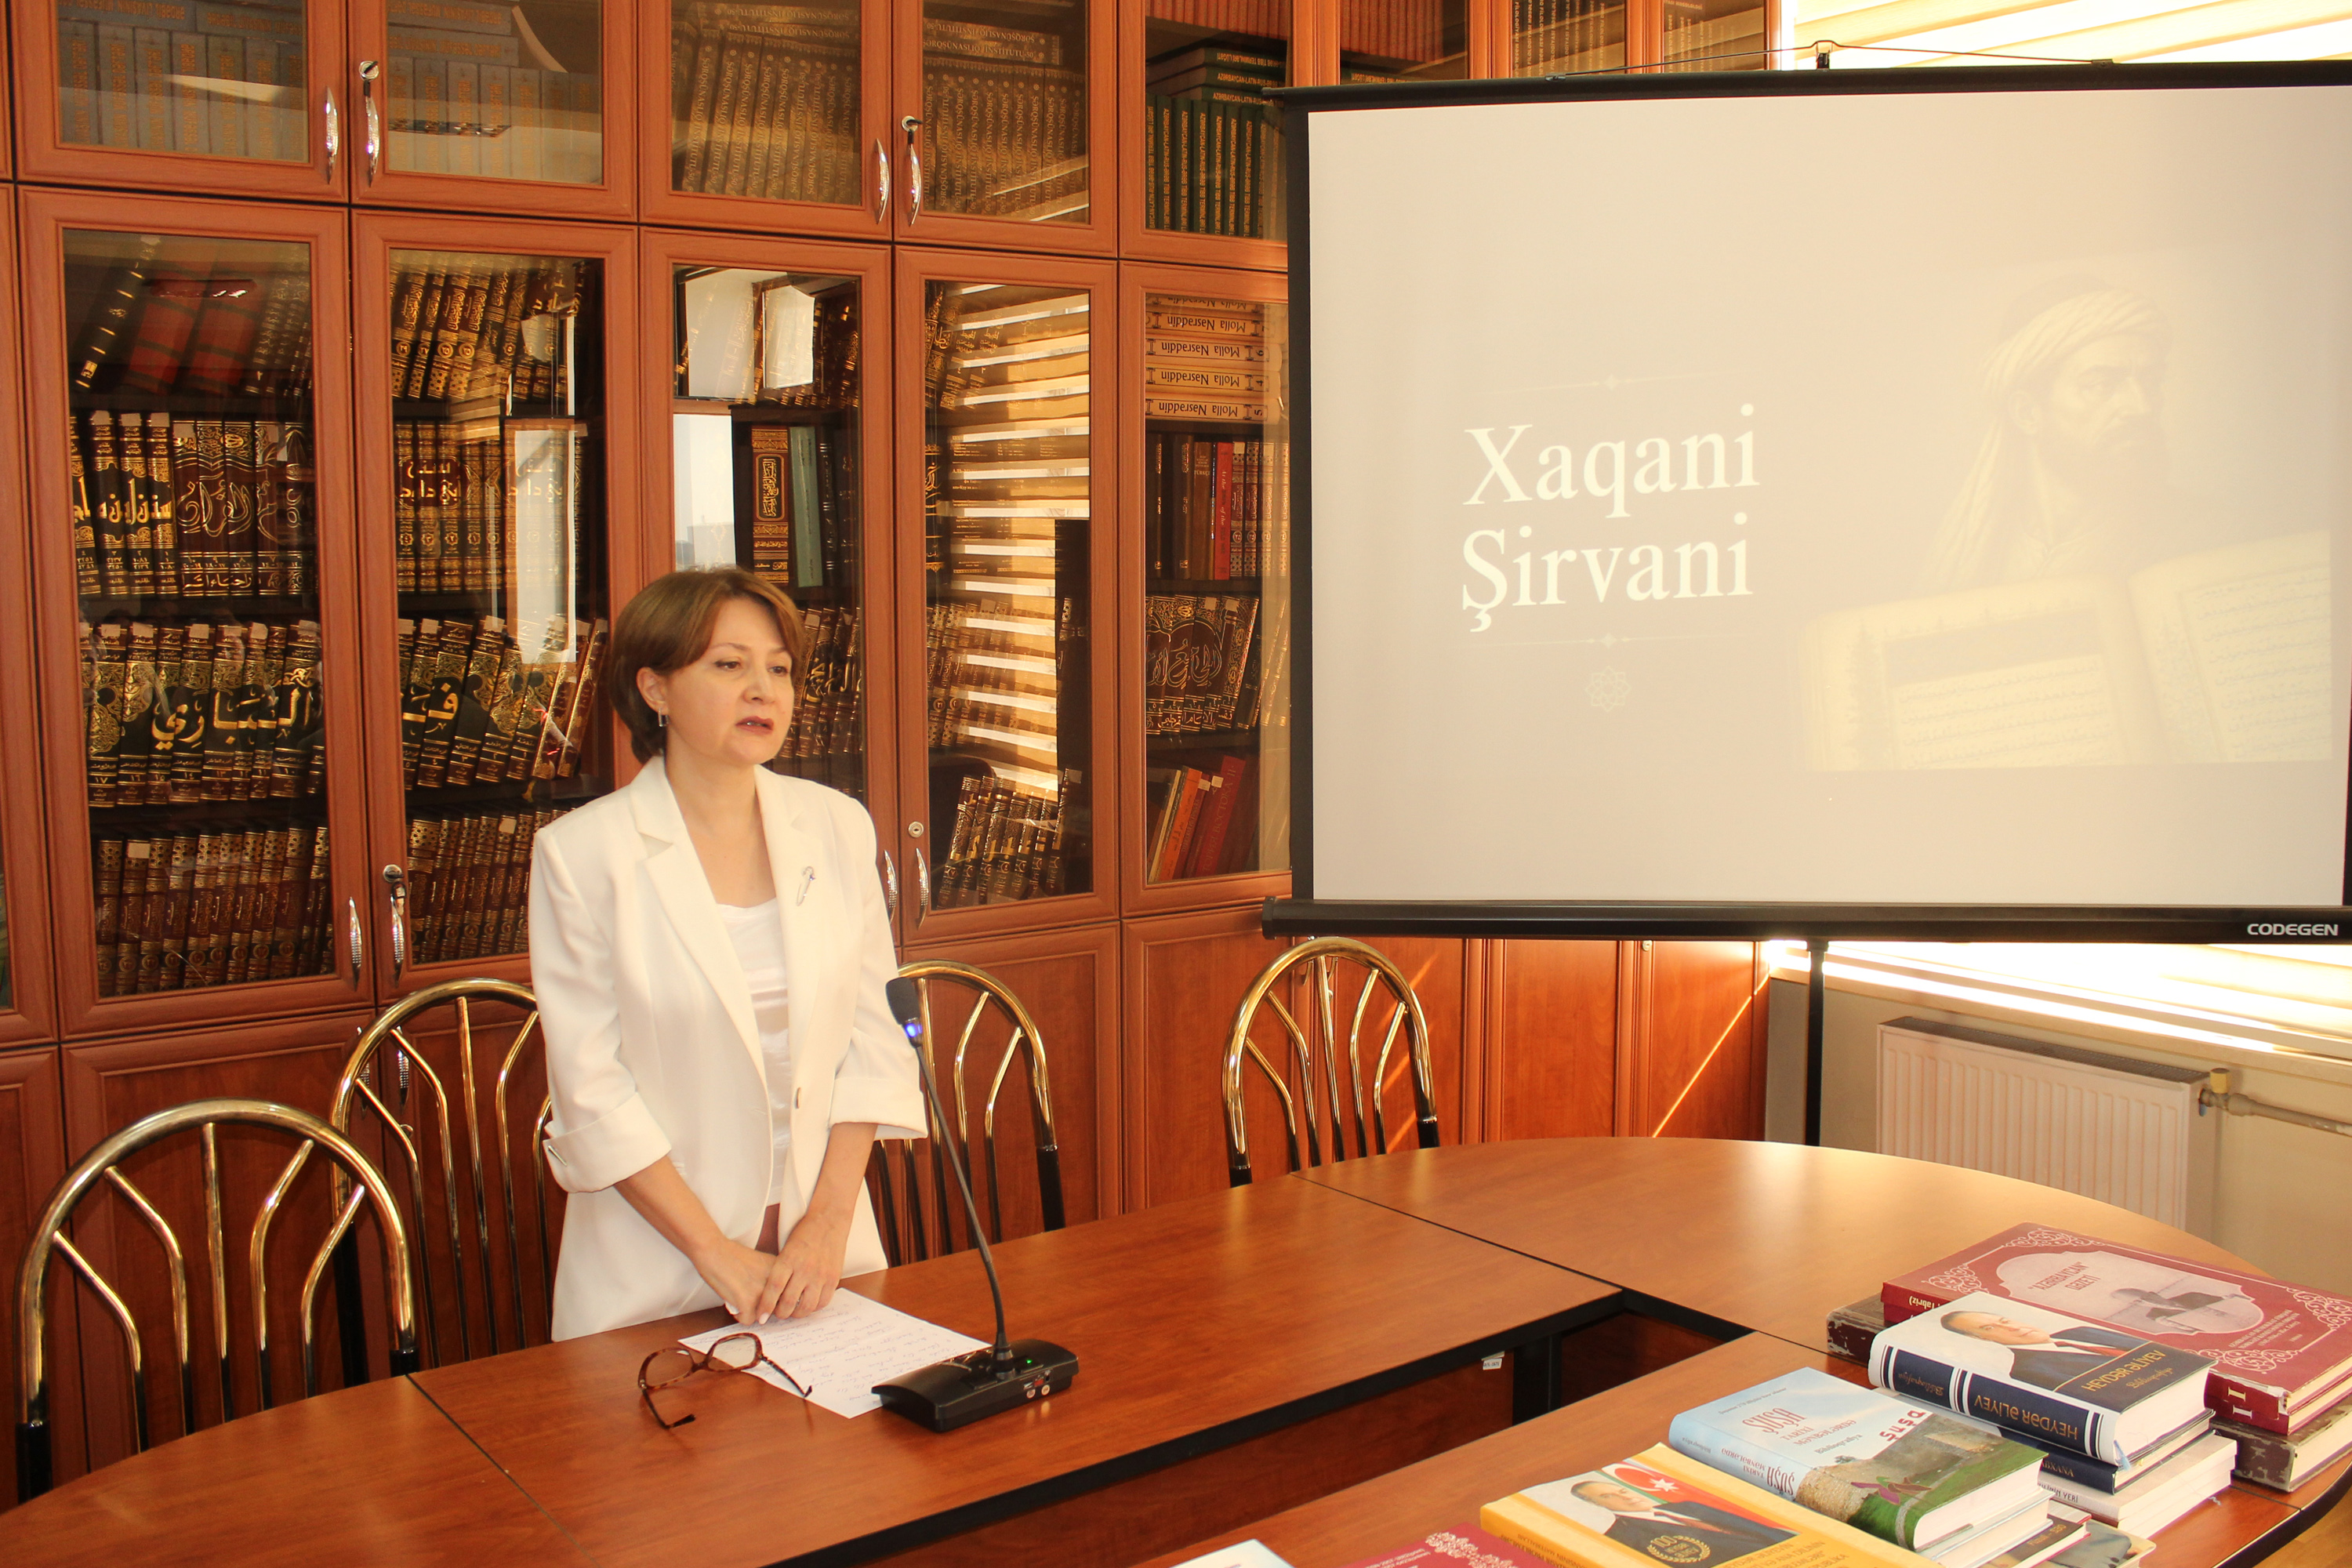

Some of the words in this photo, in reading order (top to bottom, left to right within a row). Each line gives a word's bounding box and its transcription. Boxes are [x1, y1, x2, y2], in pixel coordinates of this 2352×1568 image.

[1167, 316, 1214, 331] Nəsrəddin
[1220, 320, 1246, 333] Molla
[1162, 342, 1209, 356] Nəsrəddin
[1214, 346, 1240, 358] Molla
[1161, 371, 1209, 385] Nəsrəddin
[1214, 375, 1240, 387] Molla
[1159, 401, 1207, 416] Nəsrəddin
[1212, 405, 1238, 417] Molla
[1462, 403, 1760, 518] Xaqani
[1462, 512, 1754, 632] Şirvani
[1213, 782, 1233, 833] ВОСТОКА
[2247, 923, 2339, 936] CODEGEN
[2081, 1367, 2134, 1392] HEYDƏR
[2124, 1349, 2166, 1370] ƏLİYEV
[1974, 1394, 2019, 1420] ƏLİYEV
[1742, 1407, 1807, 1435] ŞUŞA
[2021, 1409, 2078, 1439] HEYDƏR
[1780, 1426, 1814, 1441] TARİXİ
[1793, 1419, 1857, 1446] MƏNBƏLƏRDƏ
[1721, 1448, 1766, 1471] MƏNBƏLƏRDƏ
[1742, 1465, 1764, 1479] TARİXİ
[1766, 1466, 1795, 1496] ŞUŞA
[2063, 1492, 2079, 1504] YERİ
[1650, 1534, 1678, 1548] 100
